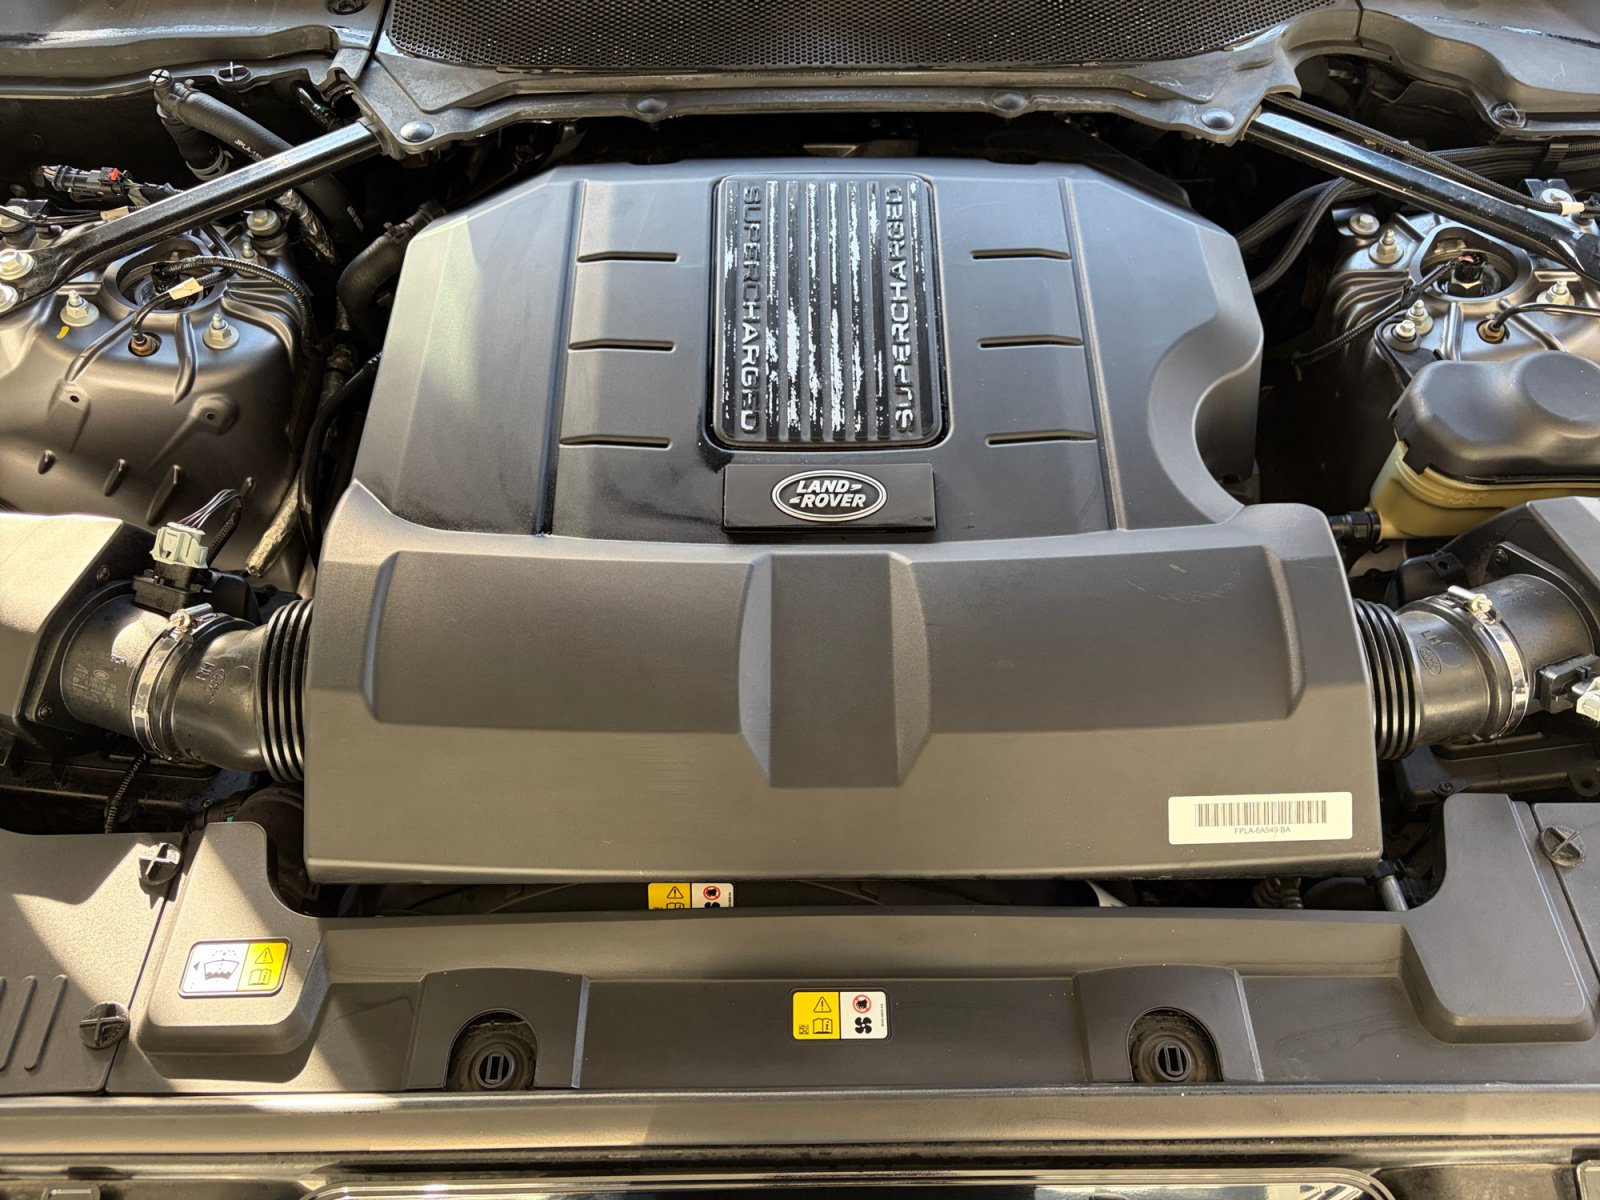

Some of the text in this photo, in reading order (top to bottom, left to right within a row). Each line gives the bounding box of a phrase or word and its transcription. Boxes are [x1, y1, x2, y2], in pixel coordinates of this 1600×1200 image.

[885, 187, 913, 433] SUPERCHARGED
[796, 480, 850, 493] LAND
[800, 494, 867, 508] ROVER
